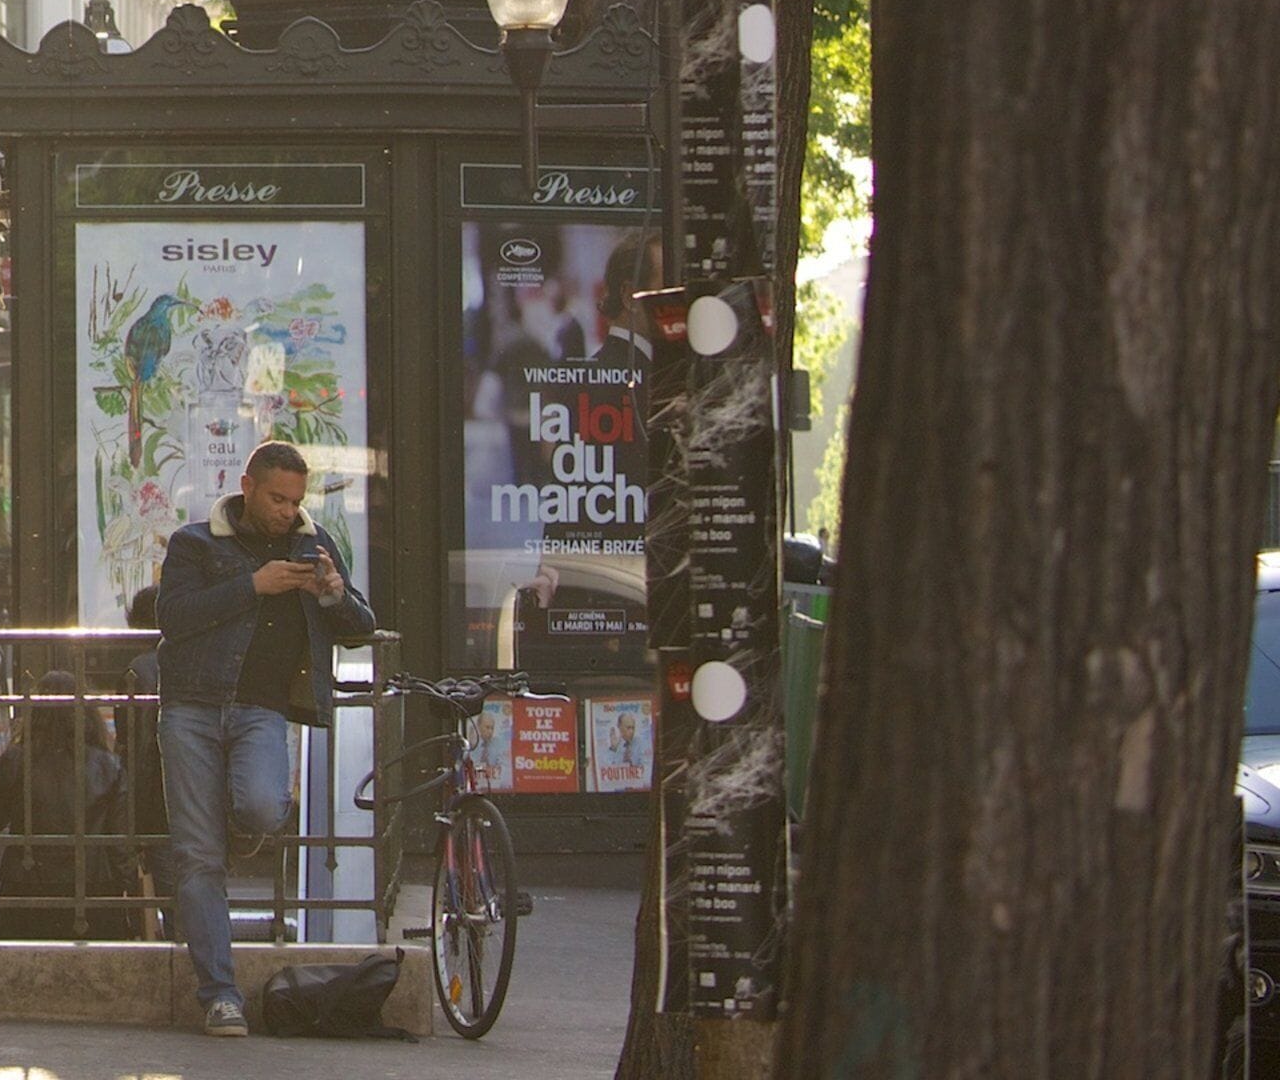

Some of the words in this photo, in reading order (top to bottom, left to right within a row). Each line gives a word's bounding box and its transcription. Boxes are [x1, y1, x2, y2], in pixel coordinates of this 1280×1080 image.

[158, 170, 281, 202] Presse
[533, 171, 639, 205] Presse
[162, 238, 277, 267] sisley
[524, 368, 586, 383] VINCENT
[530, 392, 570, 442] la
[578, 392, 634, 442] loi
[208, 443, 235, 454] eau
[552, 433, 614, 483] du
[491, 474, 648, 524] march
[524, 536, 600, 554] STÉPHANE
[603, 536, 645, 555] BRIZÉ
[551, 621, 563, 631] LE
[564, 621, 593, 631] MARDI
[595, 621, 604, 631] 19
[606, 621, 624, 631] MAI
[526, 707, 562, 717] TOUT
[536, 719, 553, 729] LE
[519, 730, 569, 741] MONDE
[533, 742, 557, 753] LIT
[515, 756, 575, 775] Society
